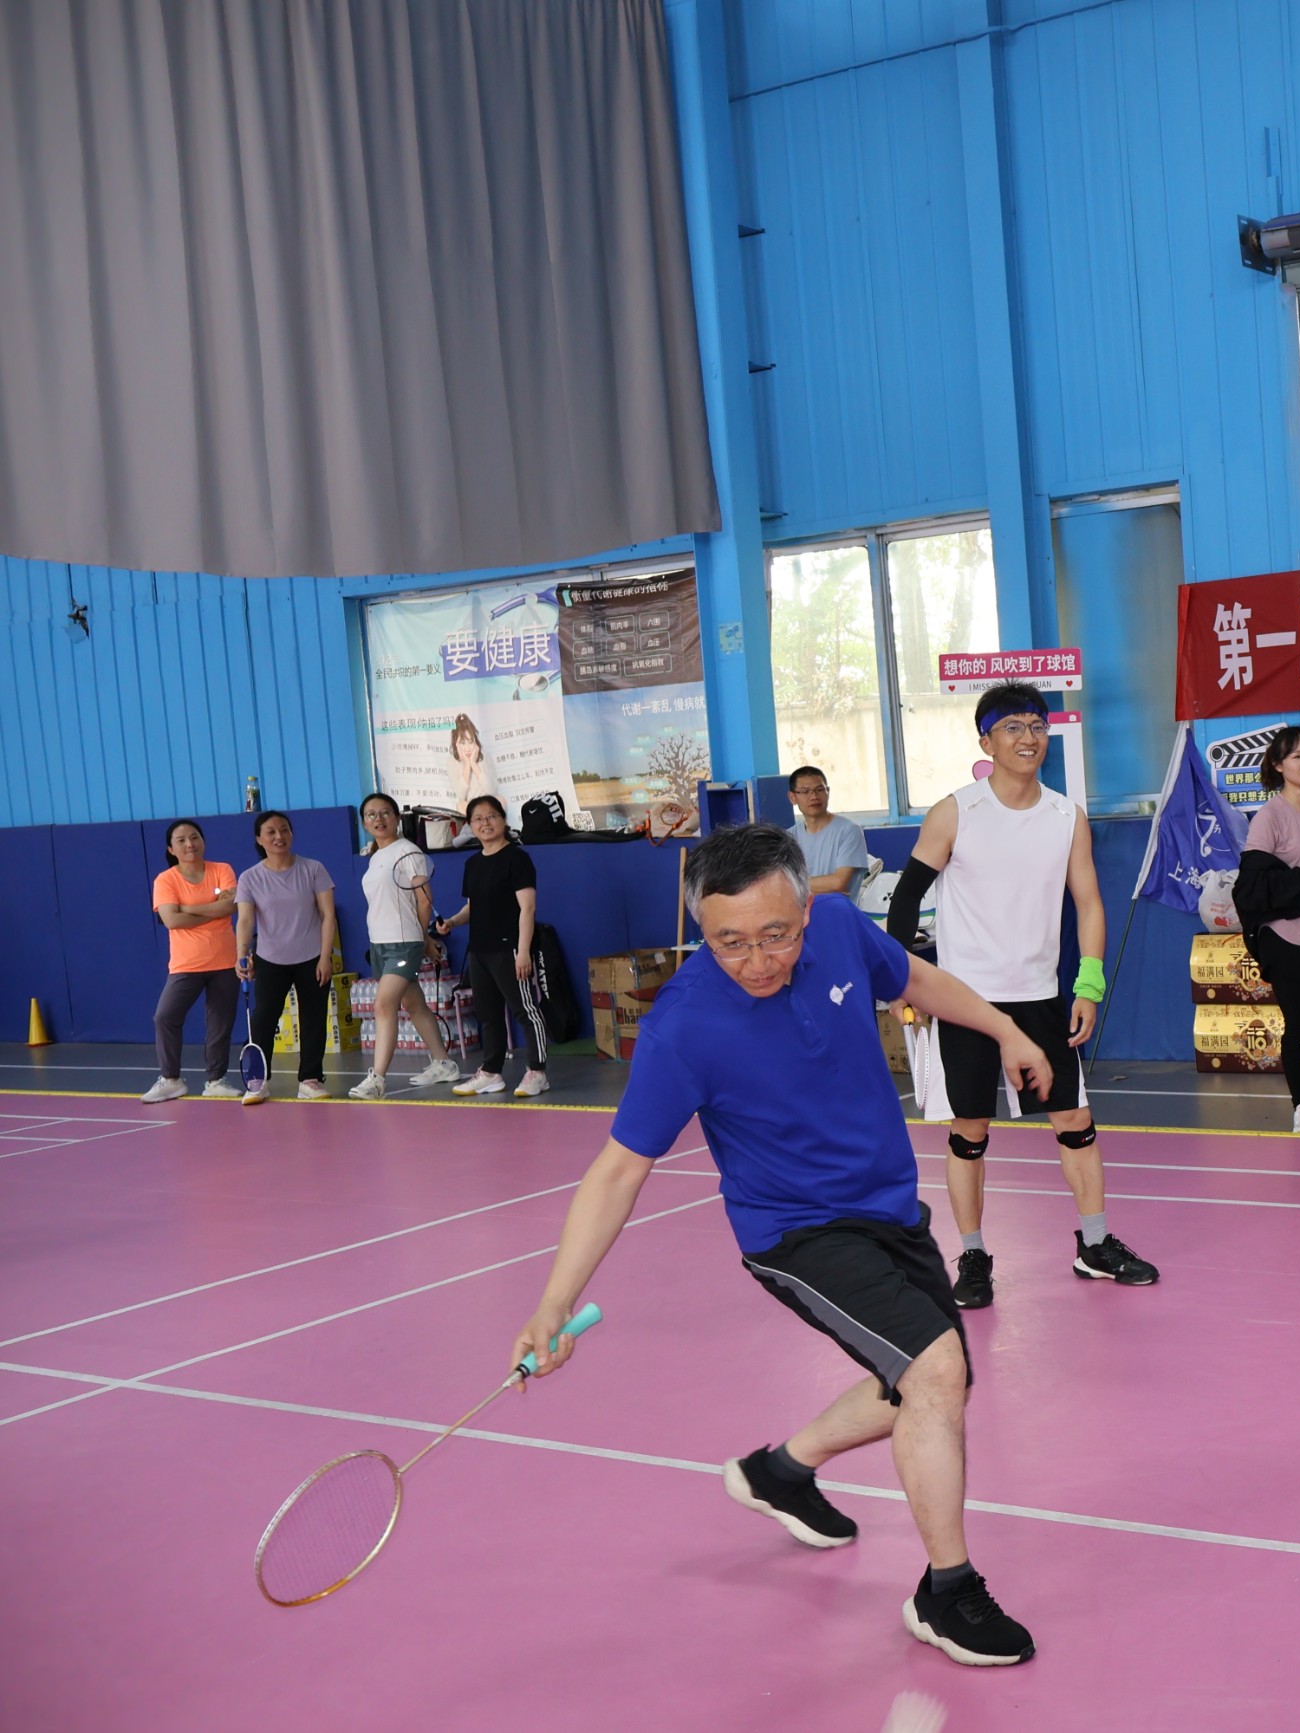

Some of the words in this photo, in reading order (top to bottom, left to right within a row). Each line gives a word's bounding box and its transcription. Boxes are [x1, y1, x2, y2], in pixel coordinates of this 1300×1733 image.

[445, 622, 553, 676] 要健康
[375, 662, 441, 680] 全民共识的第一要义
[944, 657, 988, 677] 想你的
[989, 653, 1076, 675] 风吹到了球馆
[1198, 966, 1225, 979] 福满园
[1201, 1035, 1229, 1047] 福满园
